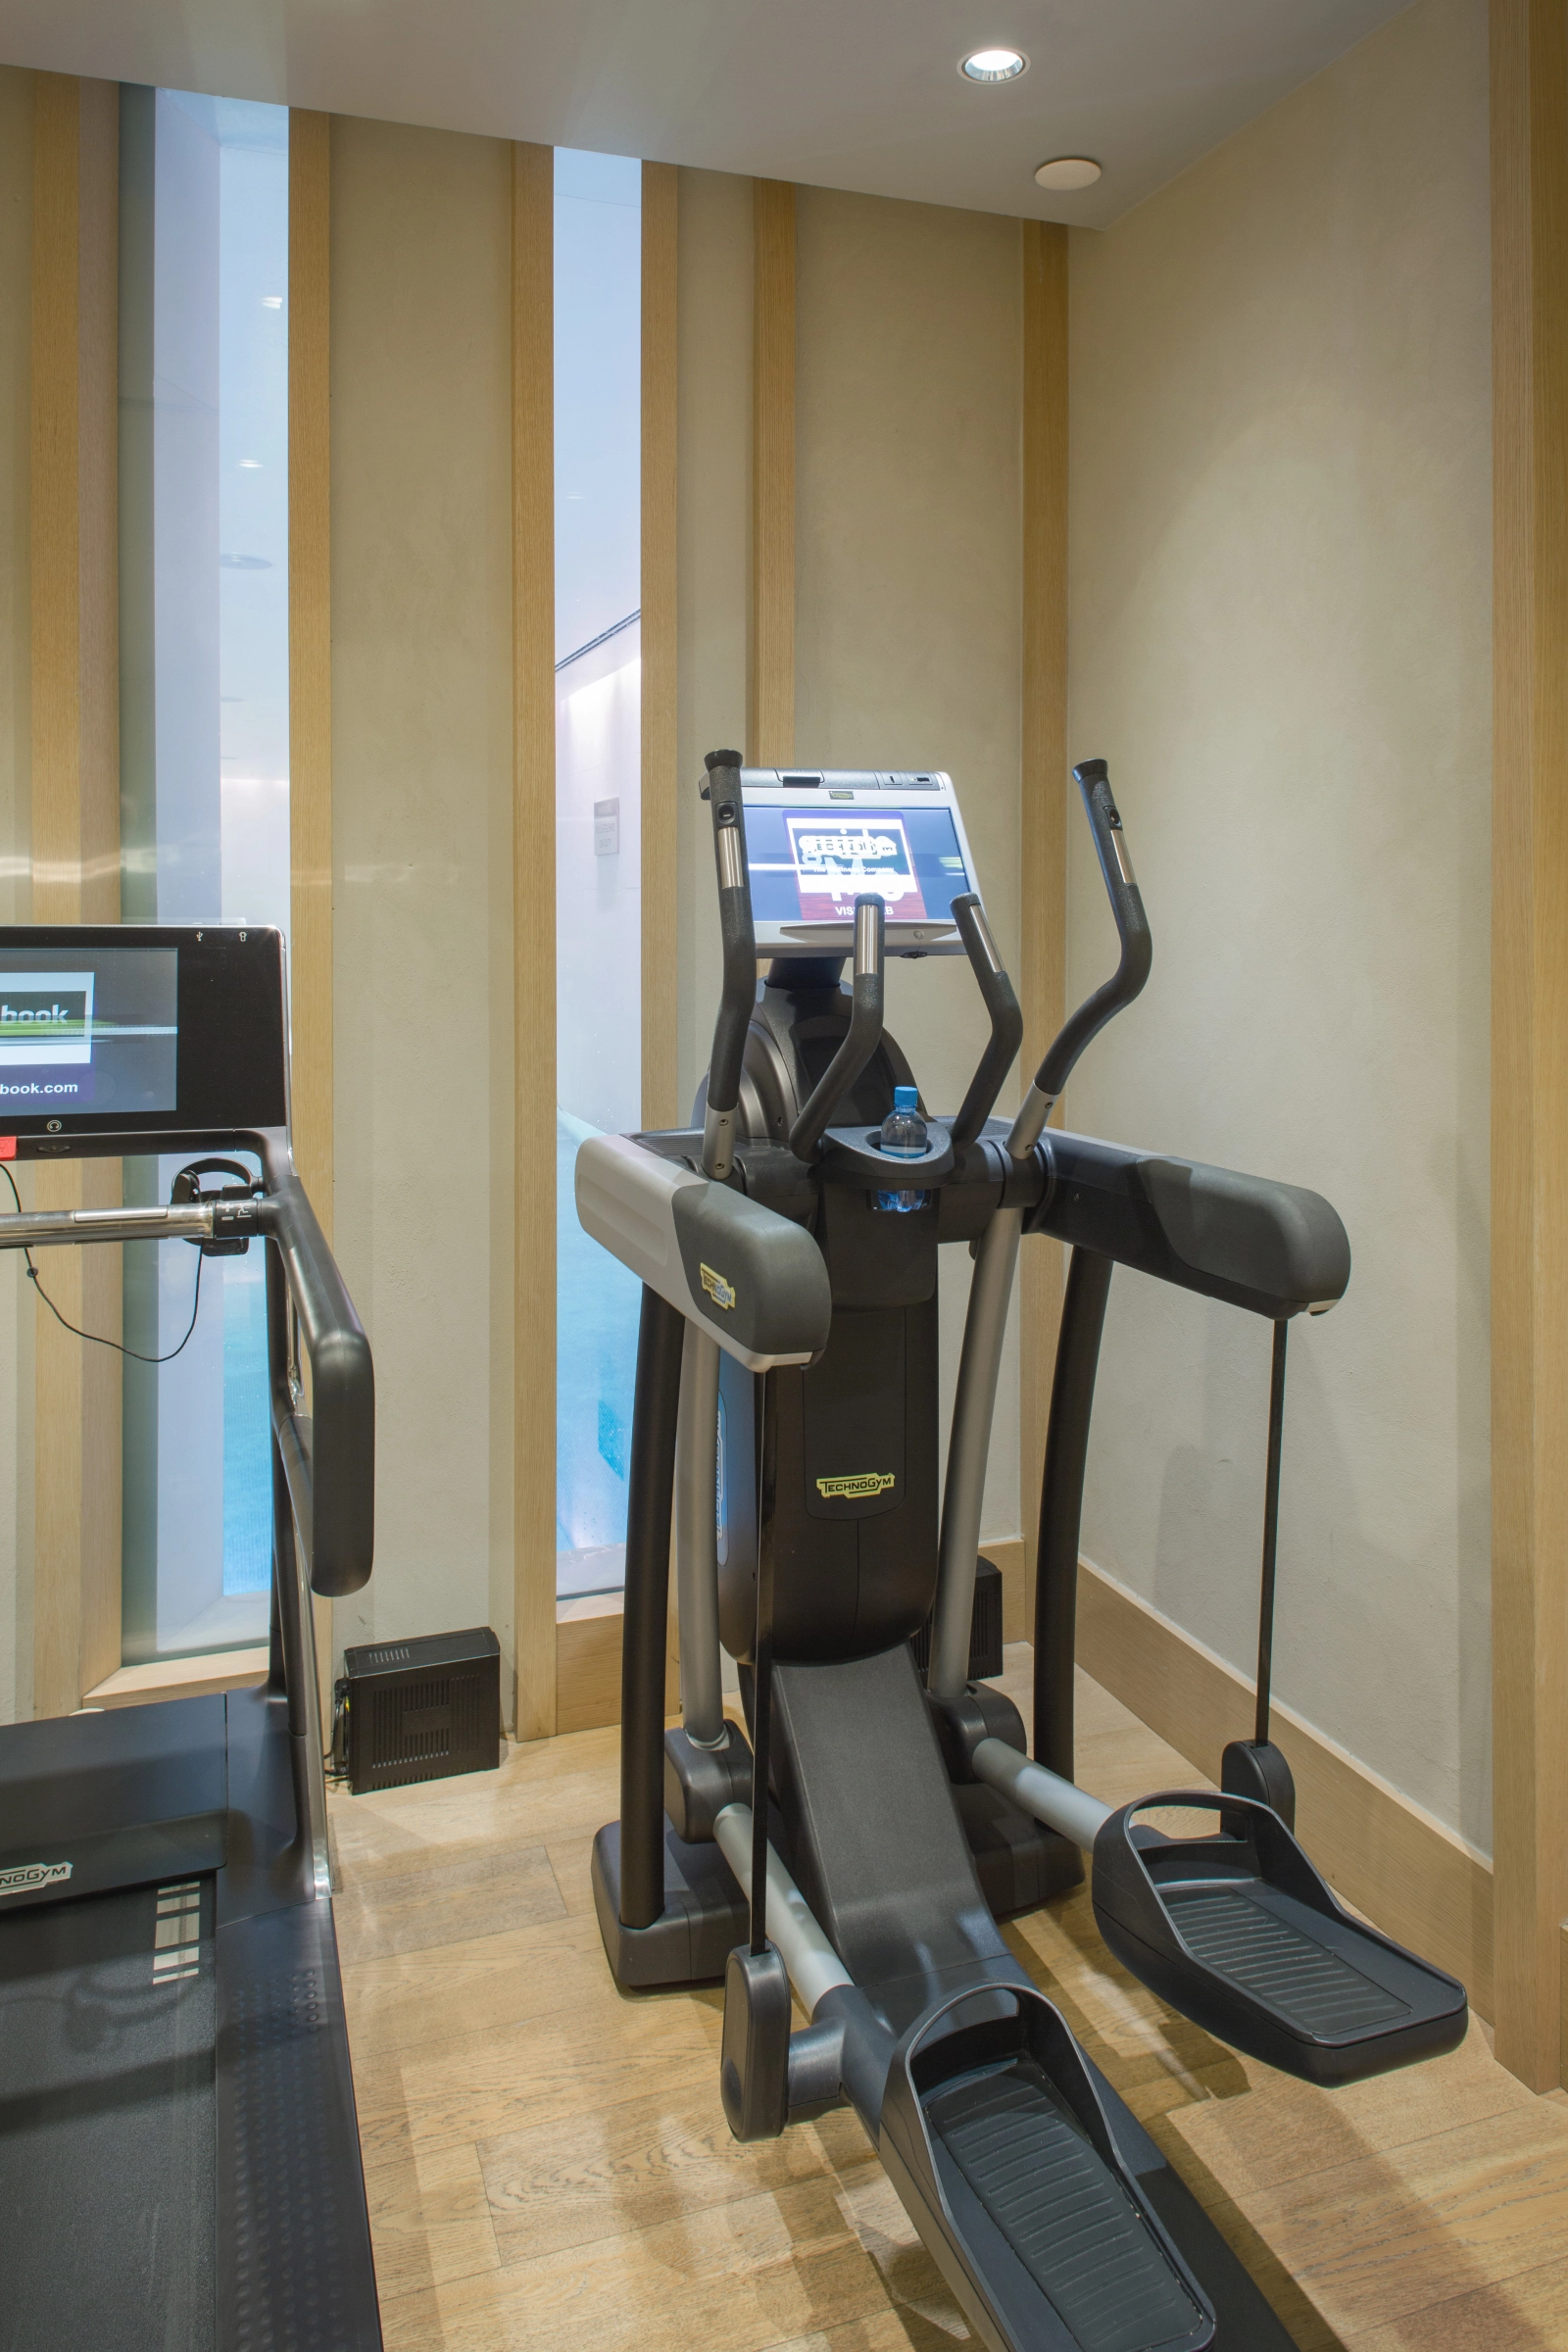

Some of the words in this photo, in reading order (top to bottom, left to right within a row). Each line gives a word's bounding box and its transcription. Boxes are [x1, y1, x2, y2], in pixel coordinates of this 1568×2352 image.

[1, 1004, 69, 1024] book
[0, 1083, 78, 1095] book.com
[819, 1477, 892, 1494] TECHNOGYM
